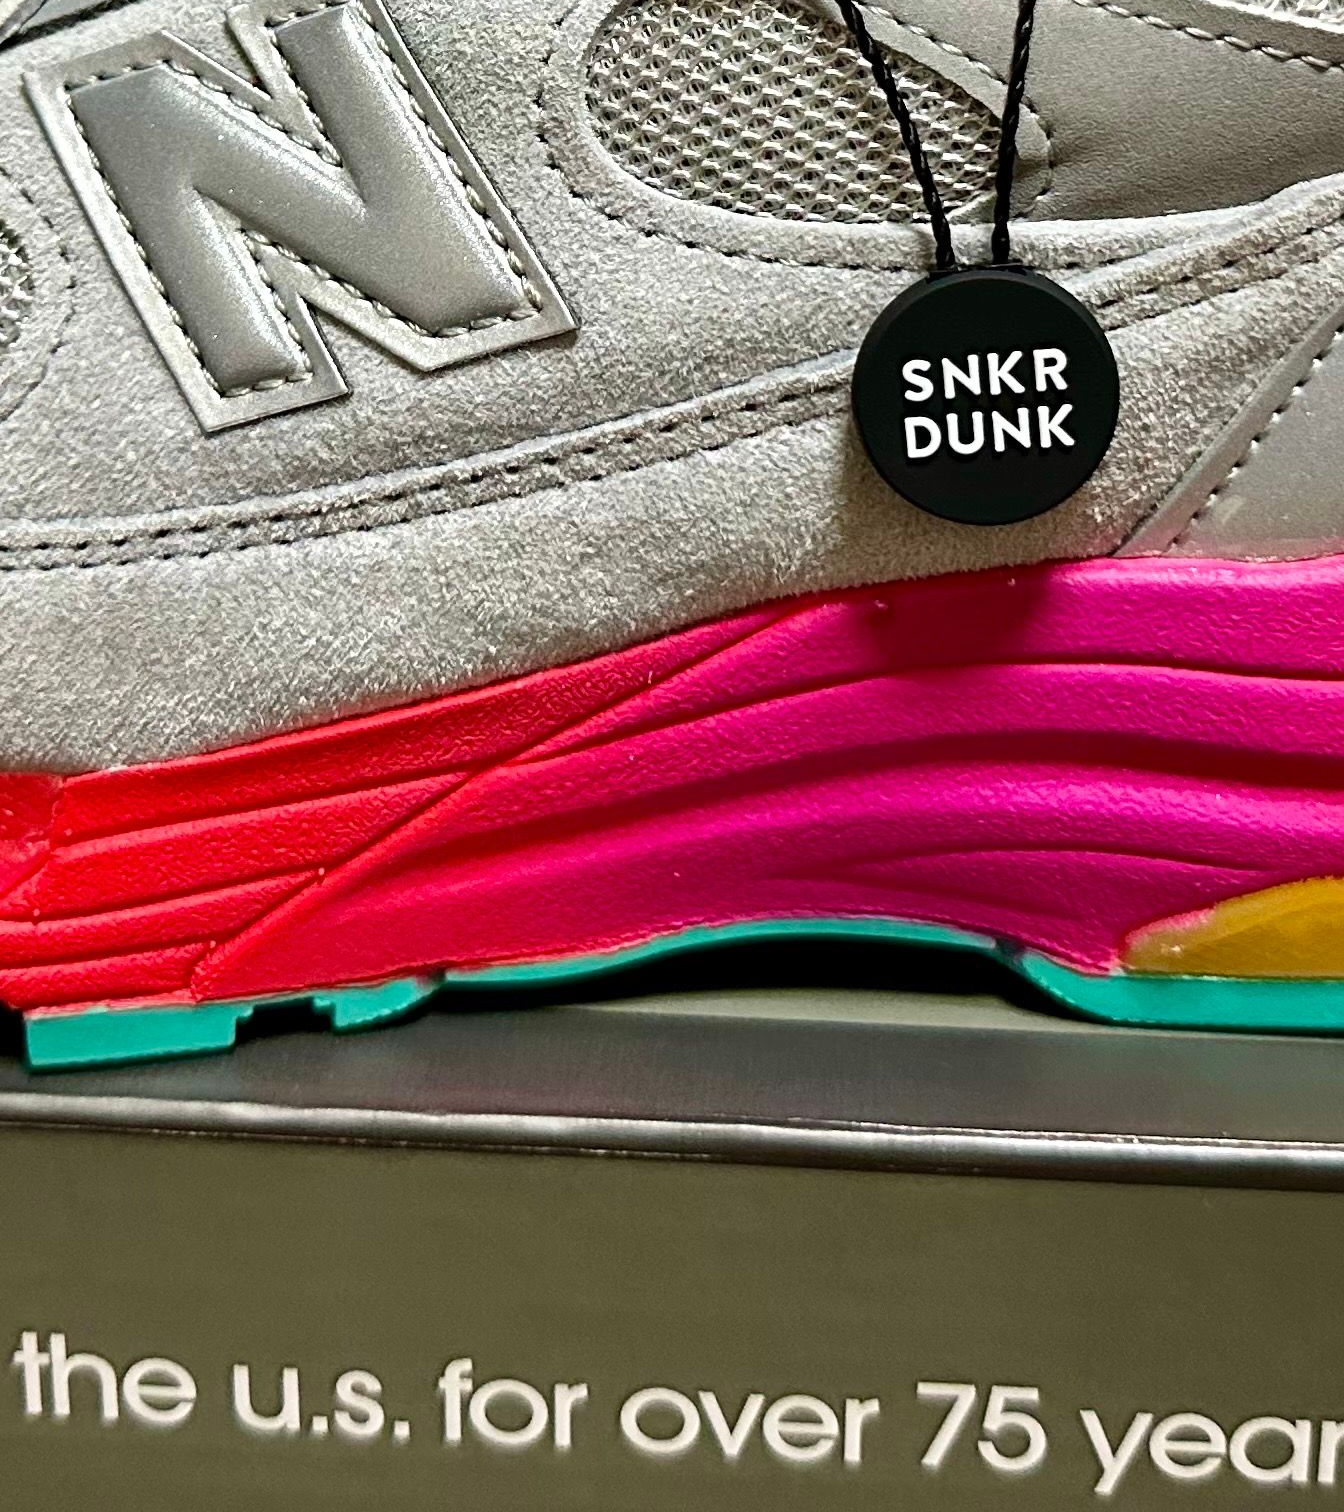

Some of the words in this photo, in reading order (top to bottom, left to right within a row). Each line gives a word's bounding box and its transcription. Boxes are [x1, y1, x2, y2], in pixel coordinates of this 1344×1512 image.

[901, 347, 1069, 403] SNKR
[903, 403, 1076, 459] DUNK
[10, 1329, 199, 1430] the
[231, 1362, 413, 1446] u.s.
[436, 1356, 591, 1454] for
[618, 1385, 883, 1469] over
[914, 1380, 1050, 1477] 75
